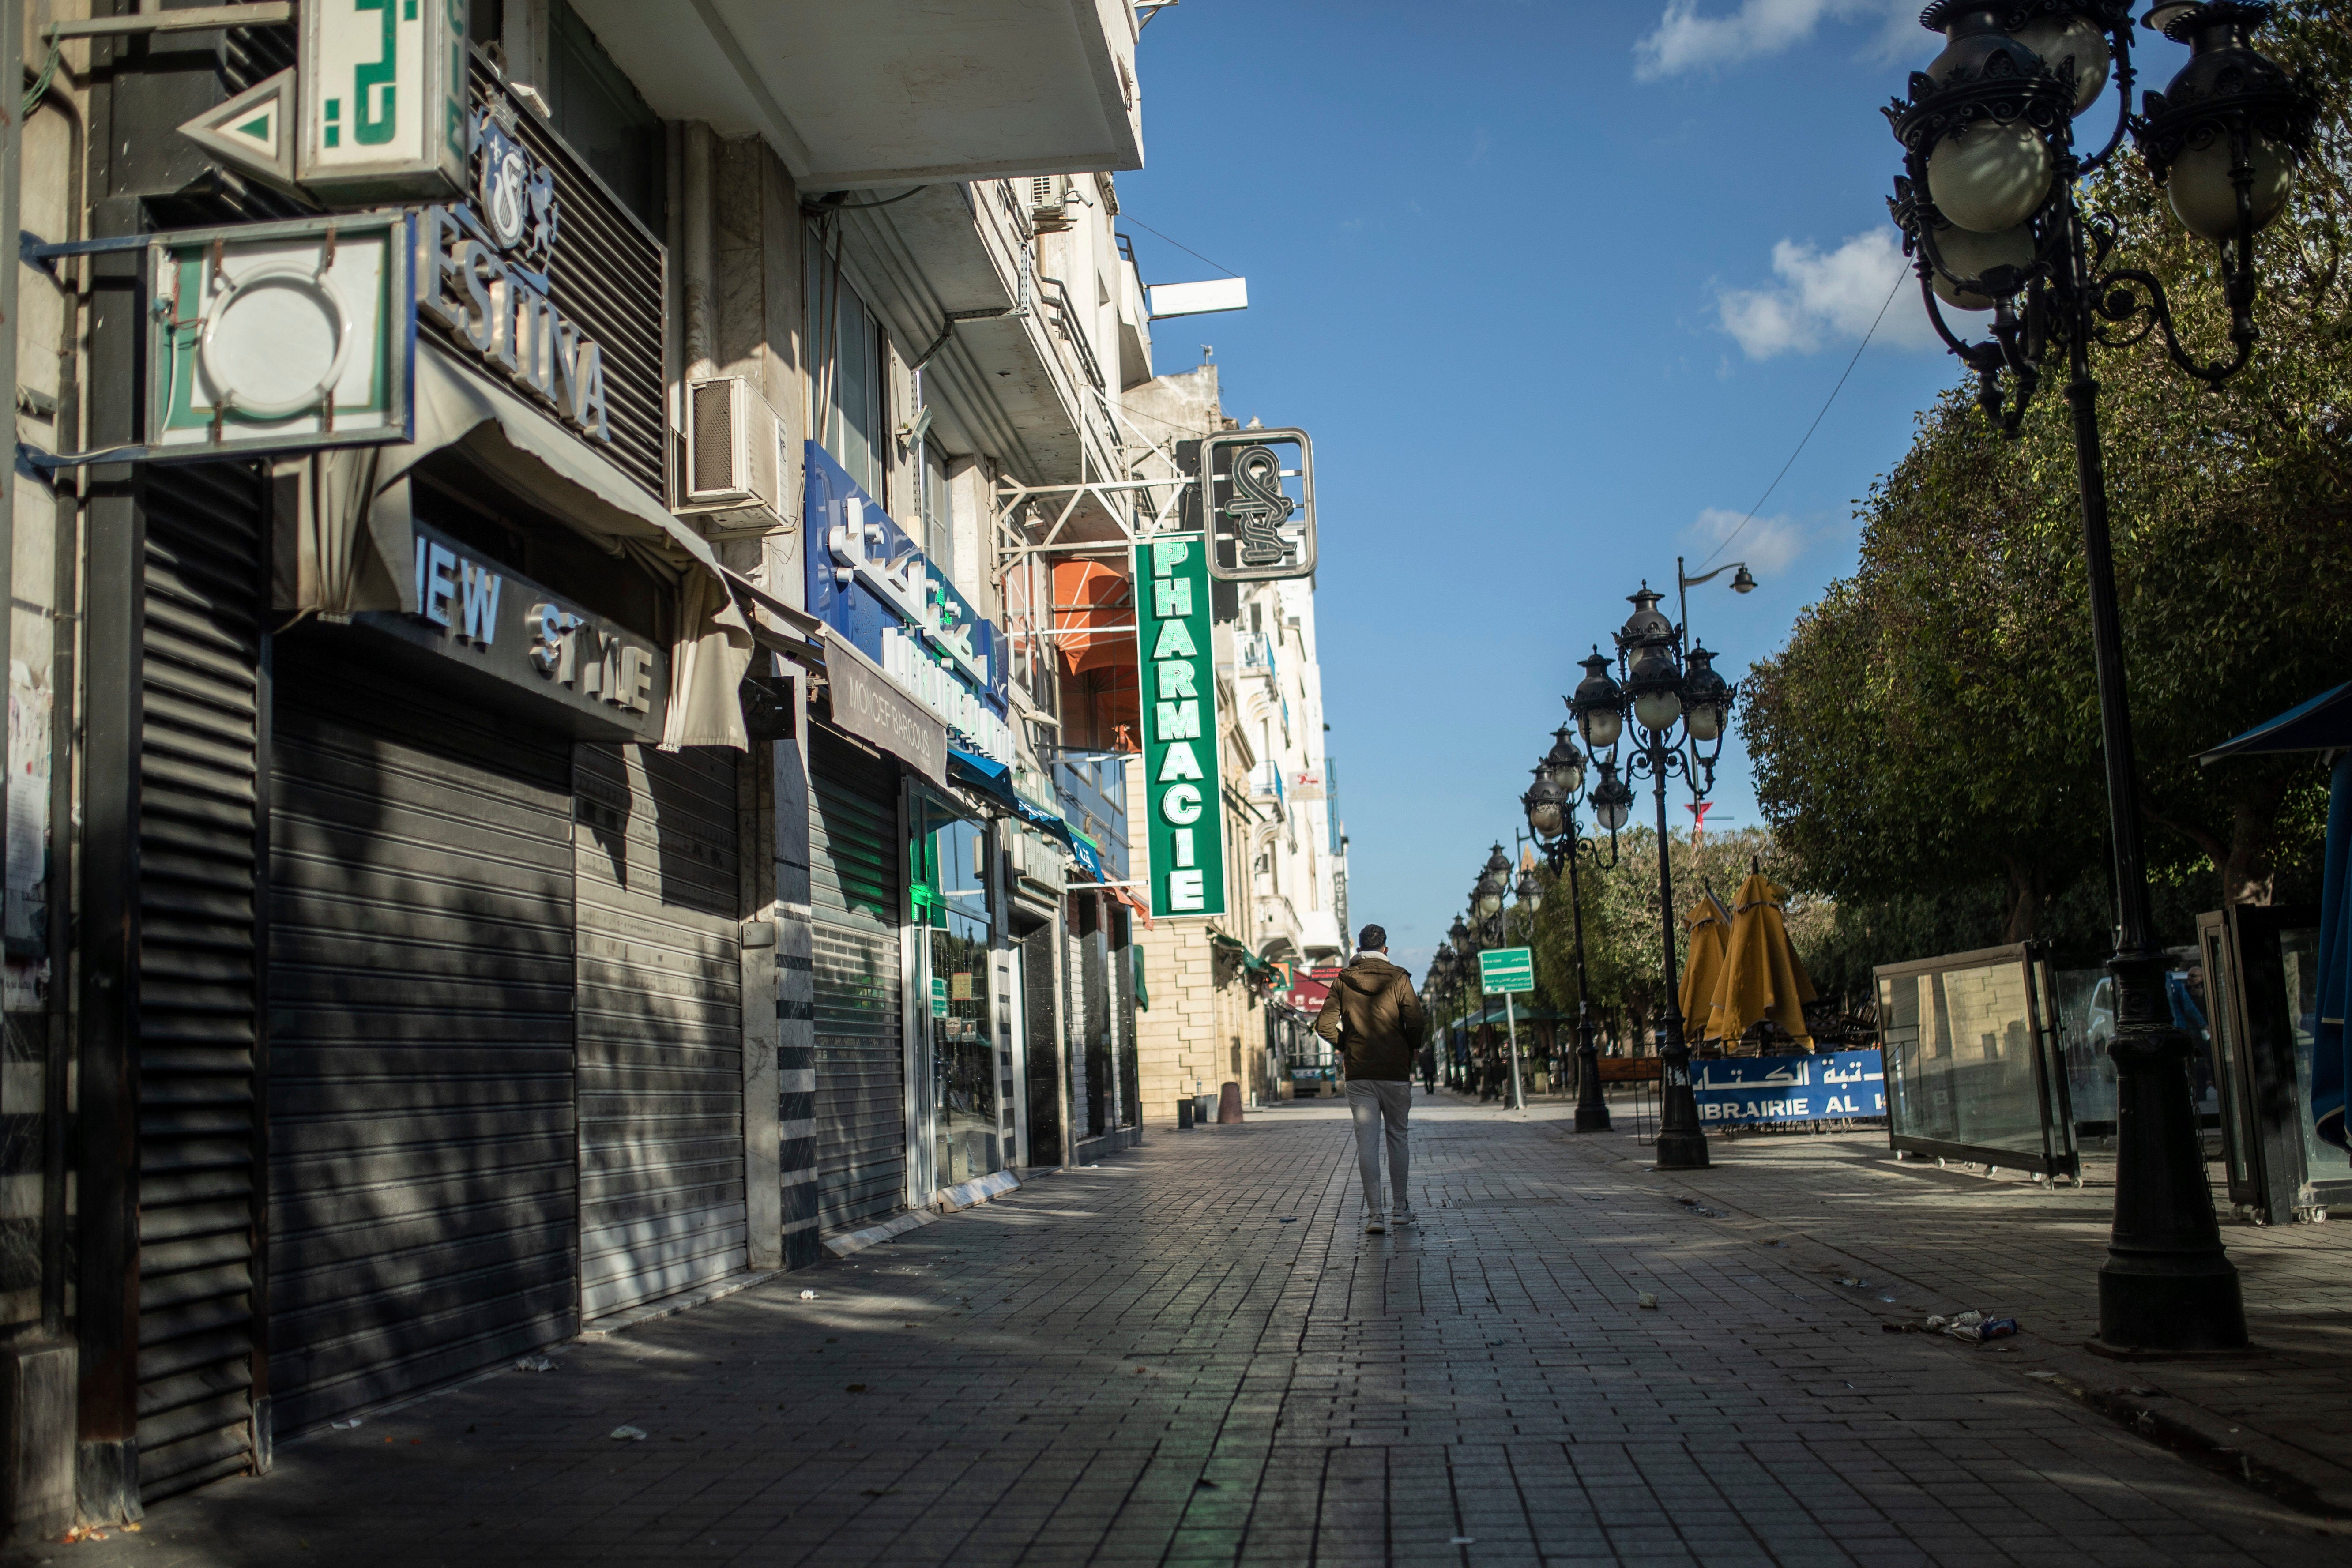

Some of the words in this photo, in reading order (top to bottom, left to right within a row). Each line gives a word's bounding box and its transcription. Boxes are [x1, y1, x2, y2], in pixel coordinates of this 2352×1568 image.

[416, 205, 610, 442] ESTINA
[829, 497, 926, 630] الكتاب
[528, 603, 652, 714] STYLE
[883, 627, 967, 736] LIBRAIRIE
[849, 676, 889, 729] MONCEF
[892, 705, 930, 758] BARCOUS
[1153, 542, 1204, 911] PHARMACIE
[1335, 876, 1345, 918] HOTEL
[1697, 1098, 1809, 1121] IBRAIRIE
[1825, 1095, 1859, 1113] AL
[1821, 1058, 1883, 1090] تبة
